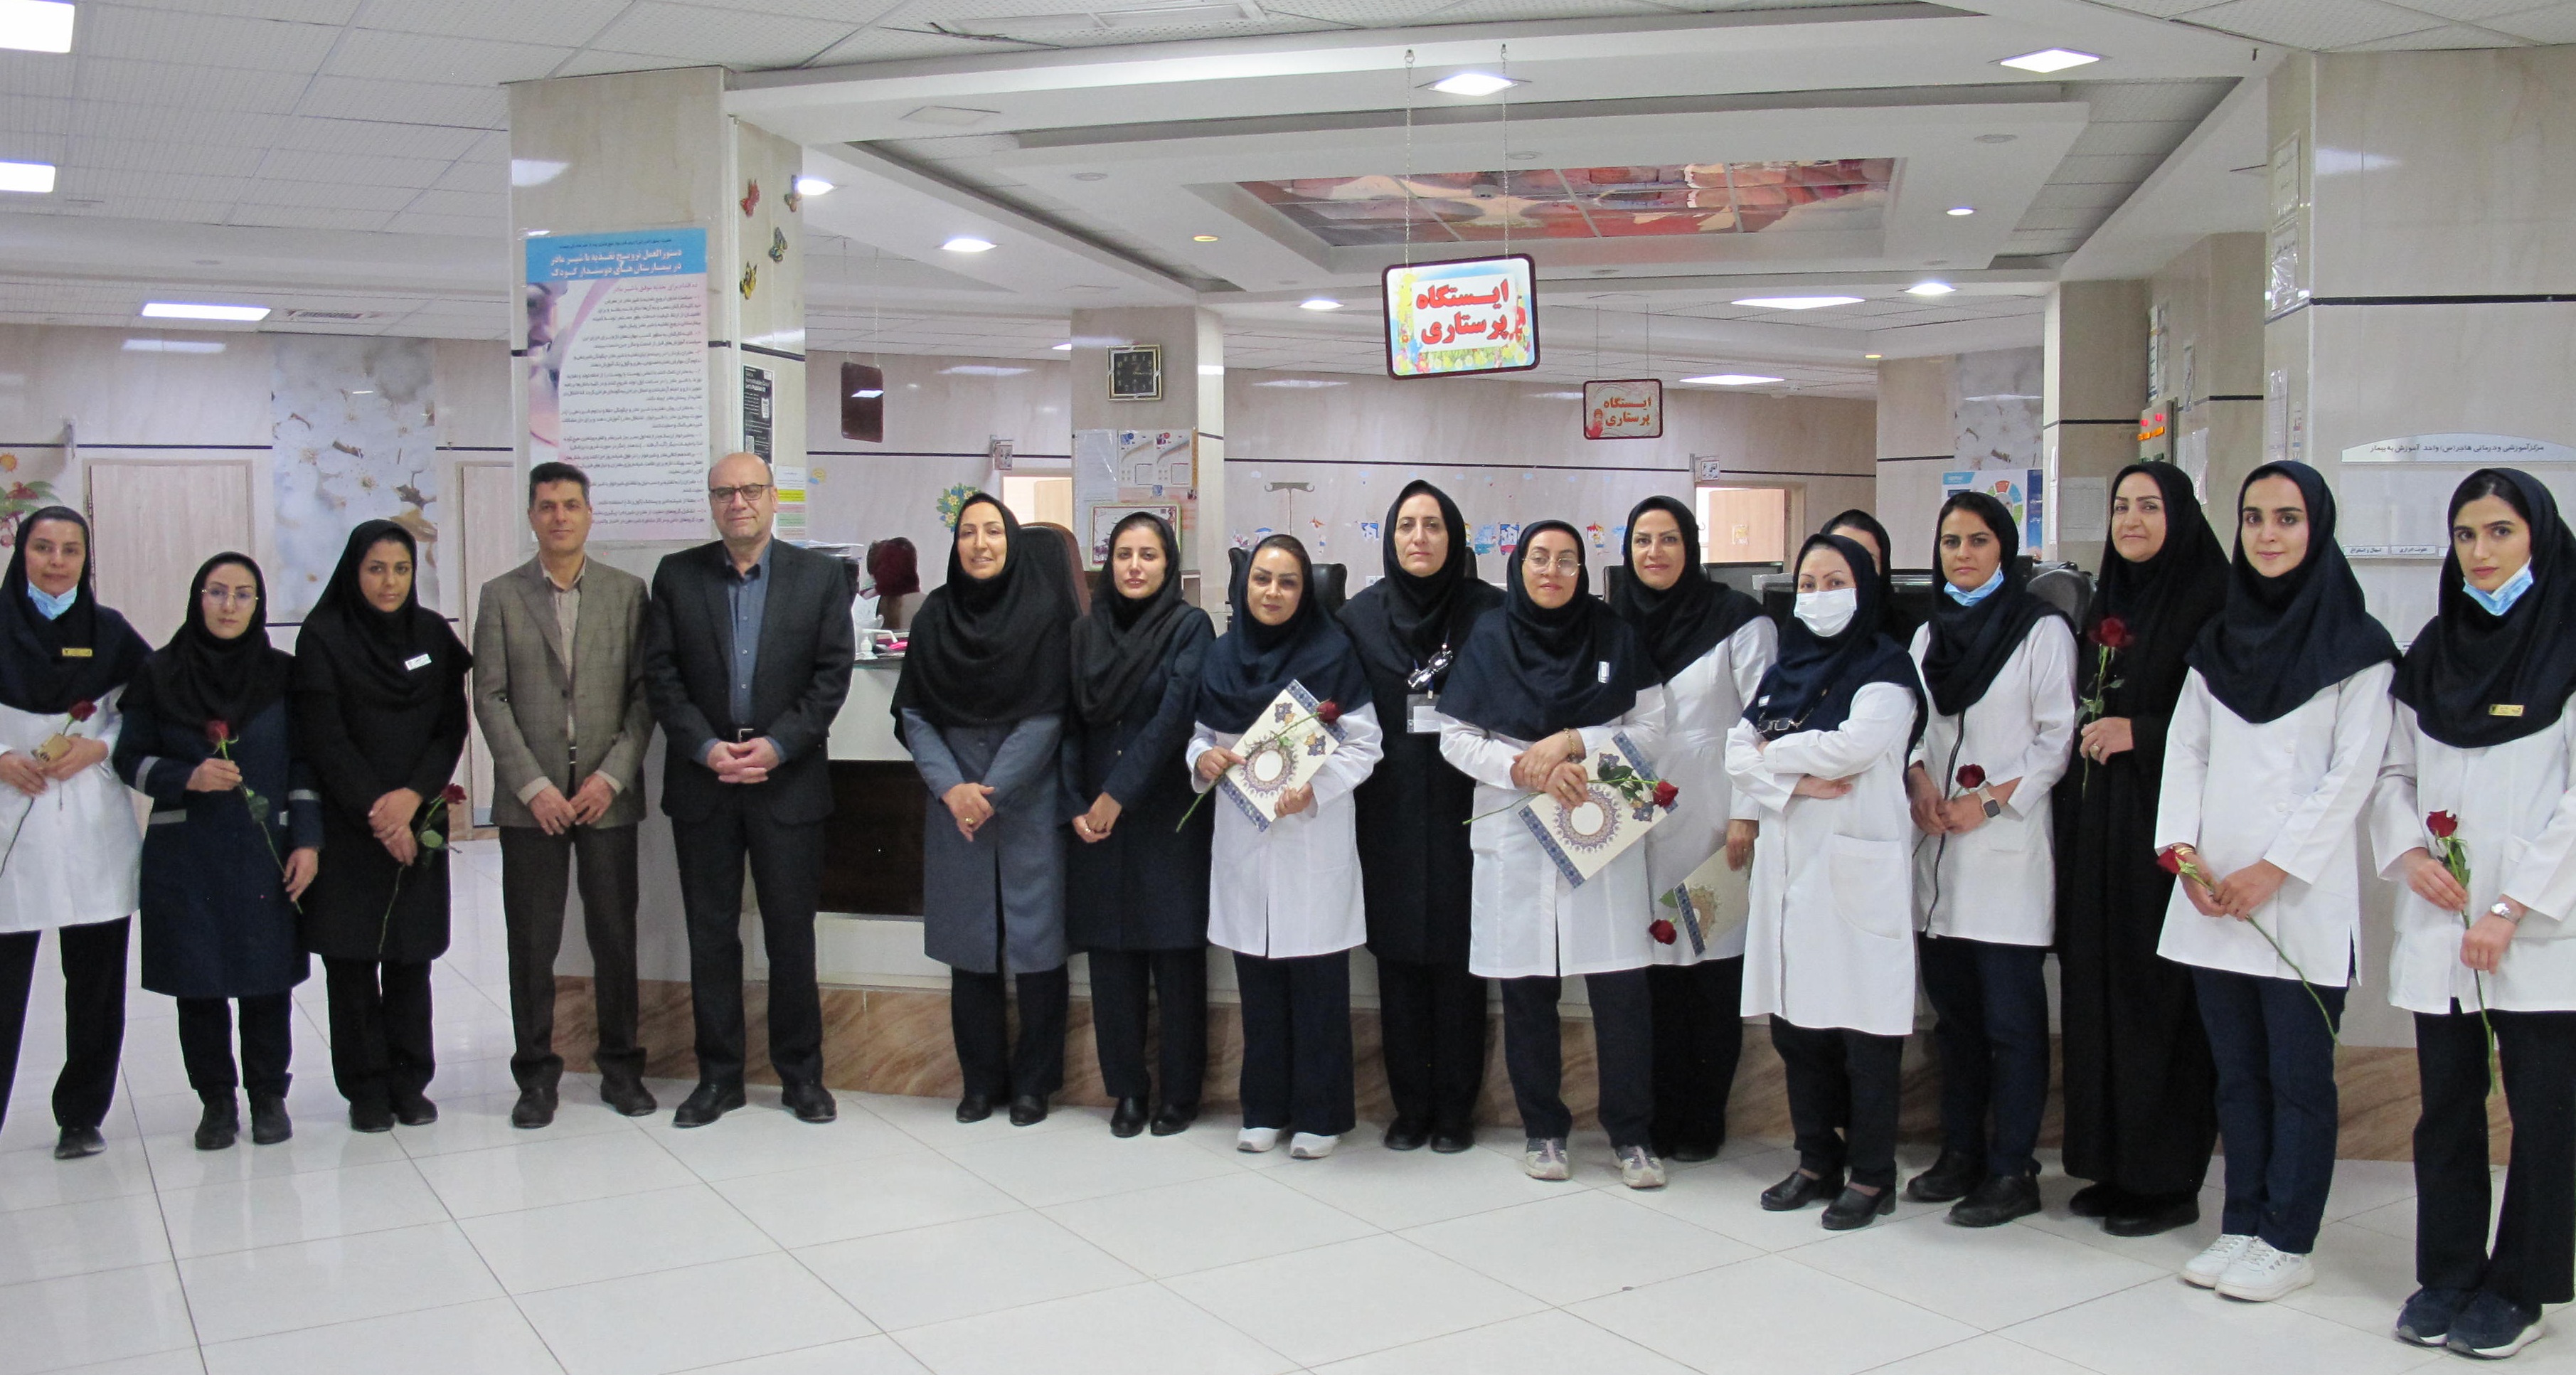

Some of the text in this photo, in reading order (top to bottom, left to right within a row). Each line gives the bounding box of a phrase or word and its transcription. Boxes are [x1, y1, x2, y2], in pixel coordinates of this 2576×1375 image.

[550, 267, 578, 279] کودک
[1416, 278, 1508, 309] ایستگاه
[1421, 311, 1509, 344] پرستاری
[1603, 395, 1652, 410] ایستگاه
[1605, 410, 1650, 427] پرستاری
[2395, 444, 2420, 453] آموزش
